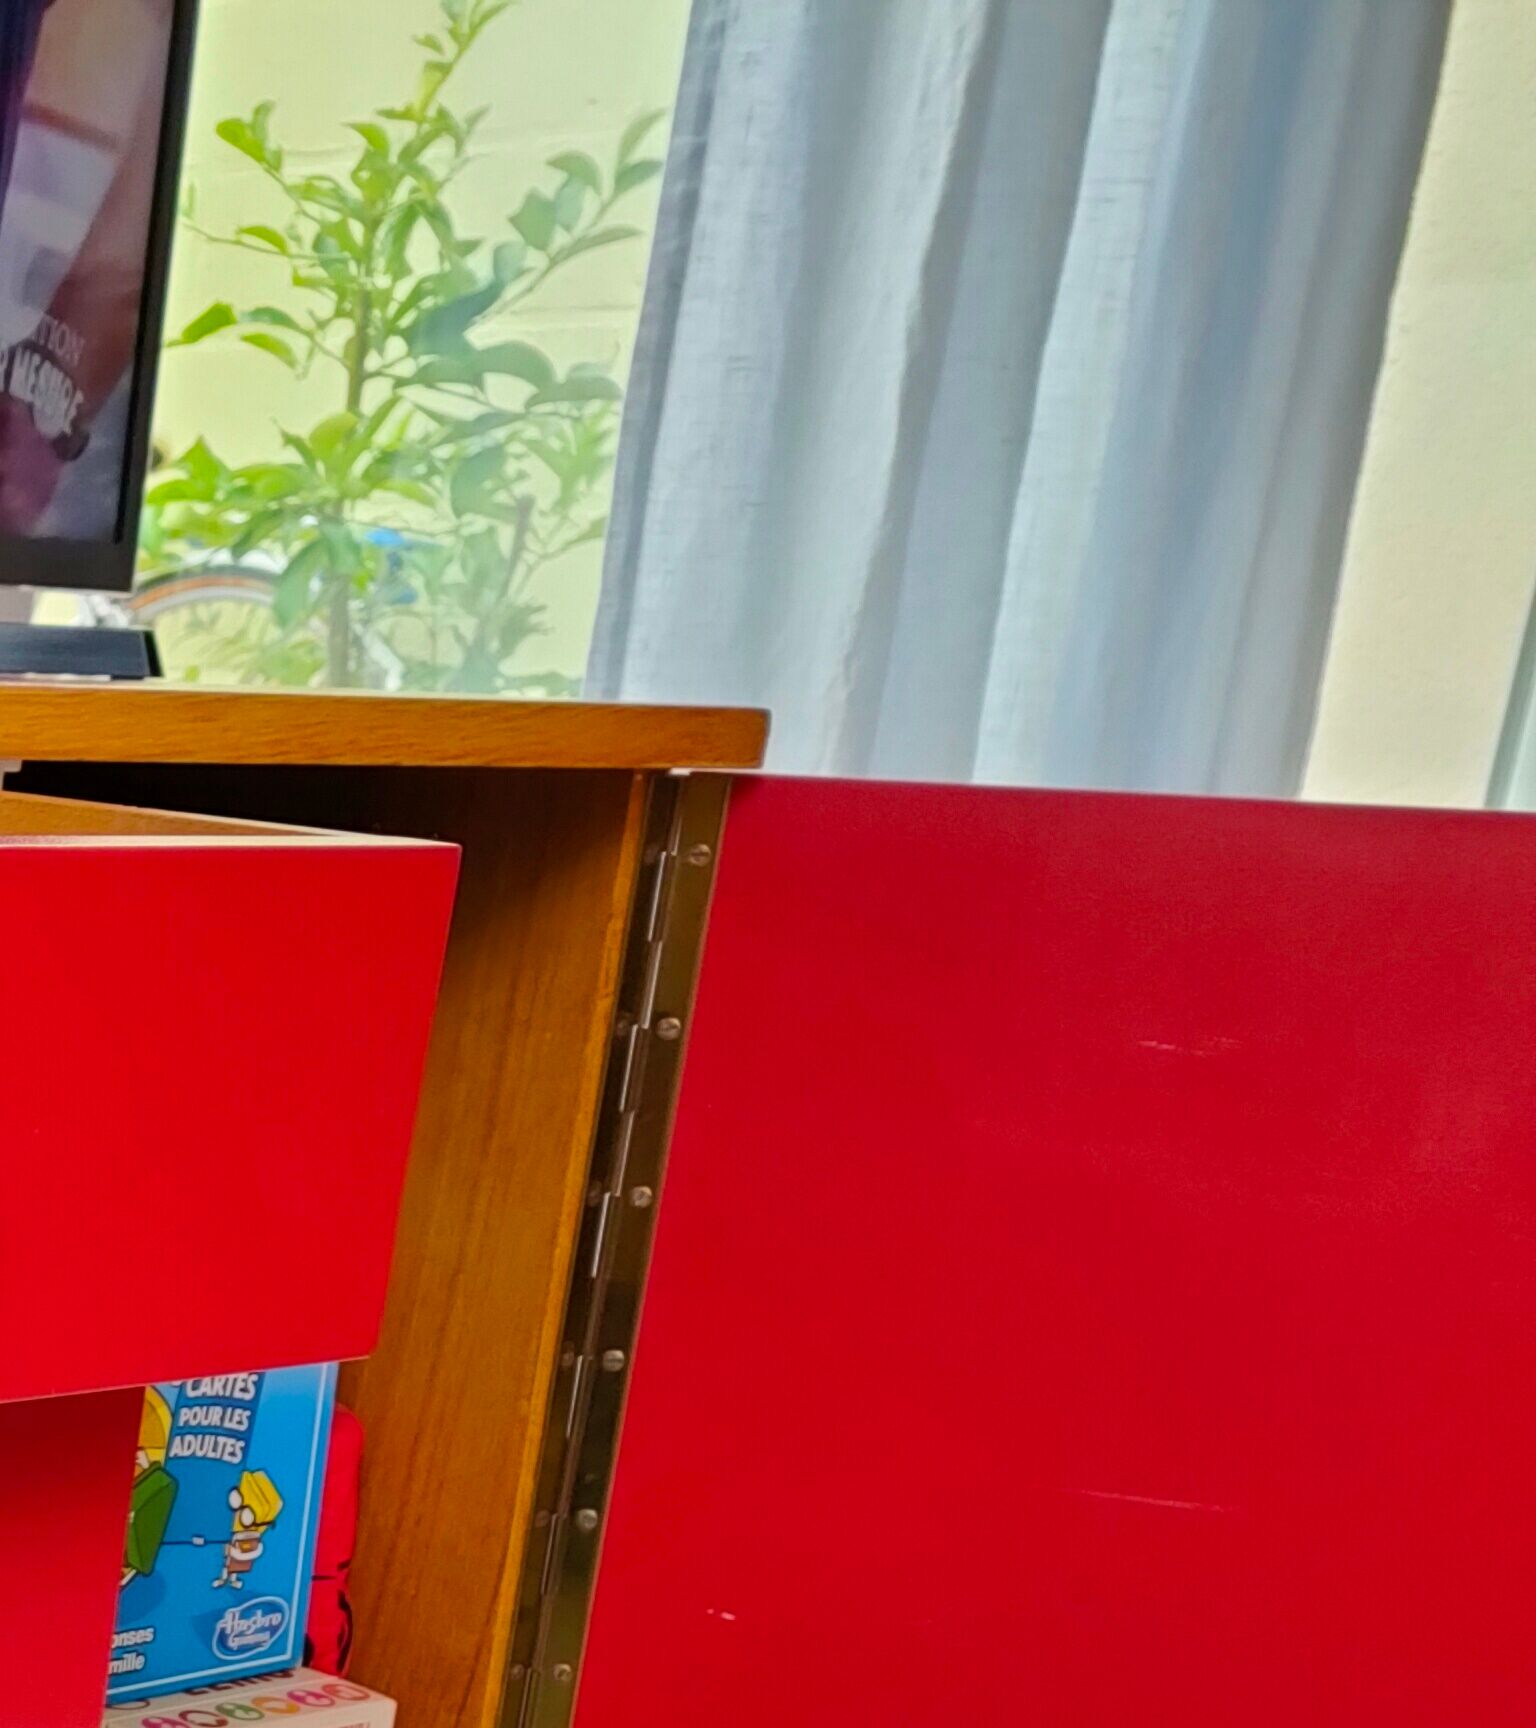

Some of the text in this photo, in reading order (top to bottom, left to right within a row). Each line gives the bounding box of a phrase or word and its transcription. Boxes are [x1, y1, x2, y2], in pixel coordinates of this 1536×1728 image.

[186, 1372, 259, 1401] CARTES
[179, 1405, 251, 1431] POUR LES
[169, 1434, 245, 1464] ADULTES
[219, 1609, 282, 1635] Hasbro
